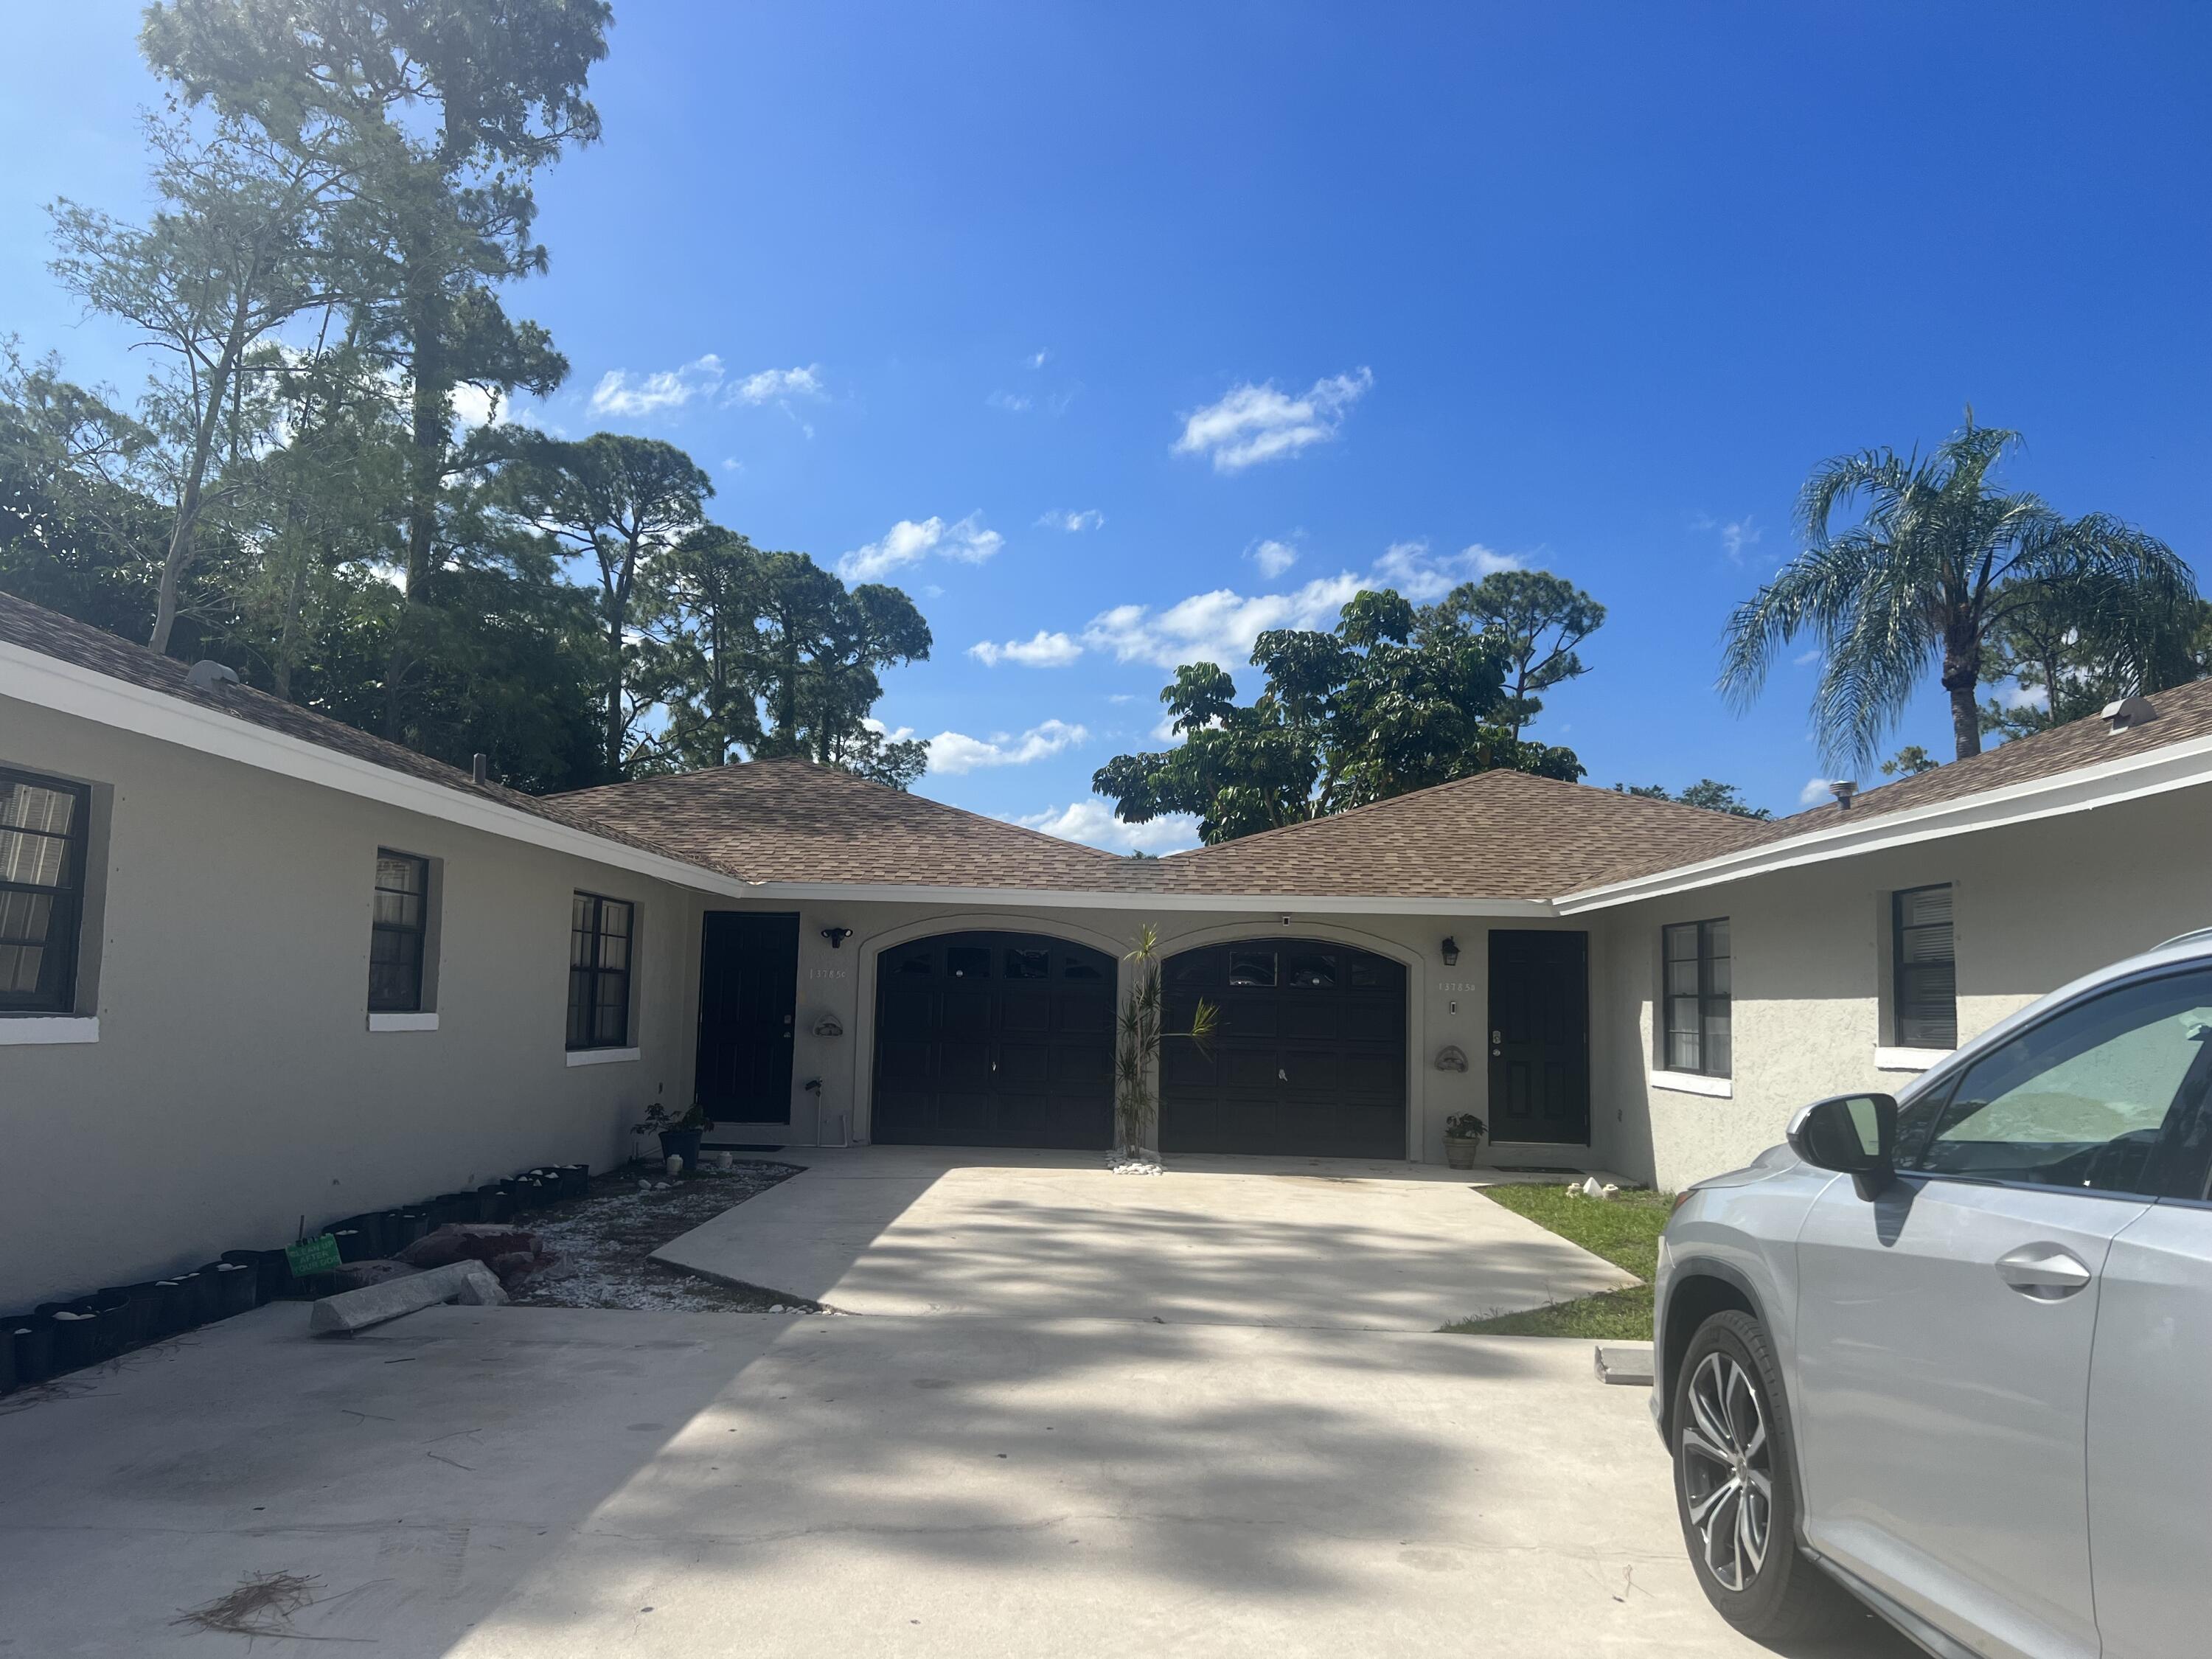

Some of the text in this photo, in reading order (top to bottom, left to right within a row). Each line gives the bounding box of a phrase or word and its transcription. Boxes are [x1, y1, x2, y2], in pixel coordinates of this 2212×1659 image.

[289, 1240, 333, 1257] CLEAN UP
[294, 1255, 340, 1275] YOUR DOG
[300, 1251, 330, 1264] AFTER
